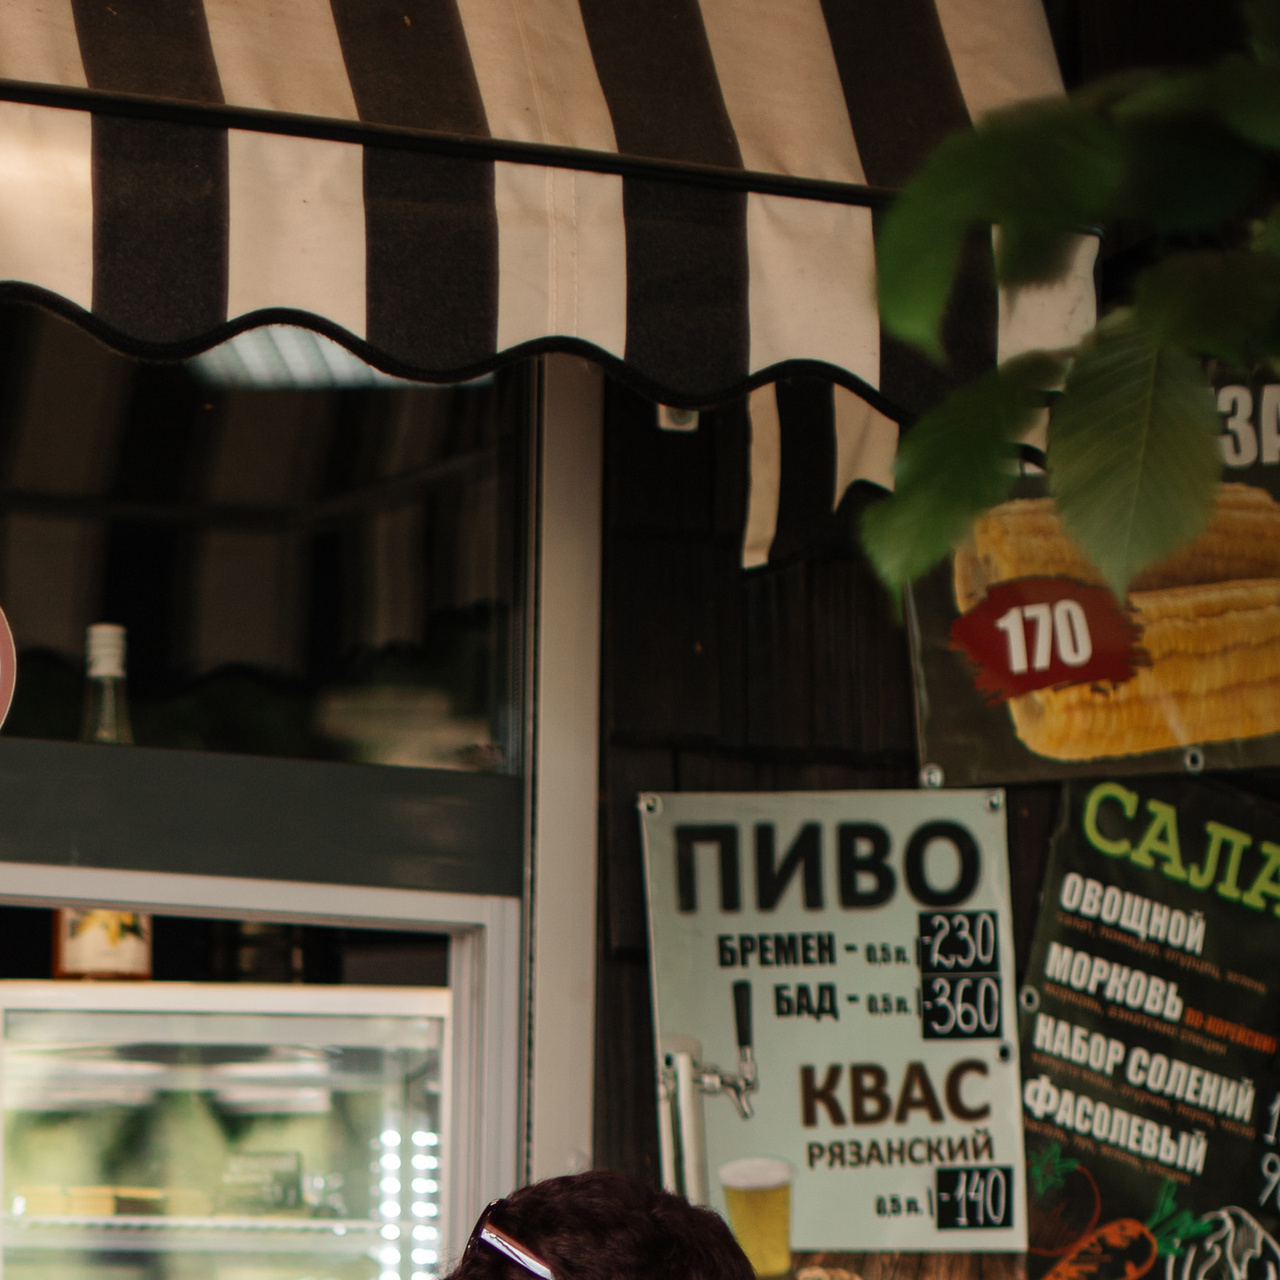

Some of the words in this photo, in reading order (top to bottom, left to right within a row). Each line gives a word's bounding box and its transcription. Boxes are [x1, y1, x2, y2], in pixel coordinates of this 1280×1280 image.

[995, 600, 1093, 675] 170
[675, 820, 981, 912] ПИВО
[717, 932, 837, 967] БРЕМЕН
[865, 942, 892, 966] 0,5
[1060, 872, 1206, 956] ОВОЩНОЙ
[774, 982, 839, 1021] БАД
[866, 993, 893, 1017] 0,5
[1044, 941, 1183, 1022] МОРКОВЬ
[801, 1059, 990, 1126] КВАС
[1033, 1012, 1126, 1076] НАБОР
[1126, 1046, 1256, 1124] СОЛЕНИЙ
[807, 1128, 995, 1169] РЯЗАНСКИЙ
[1023, 1074, 1208, 1176] ФАСОЛЕВЫЙ
[875, 1194, 902, 1217] 0,5
